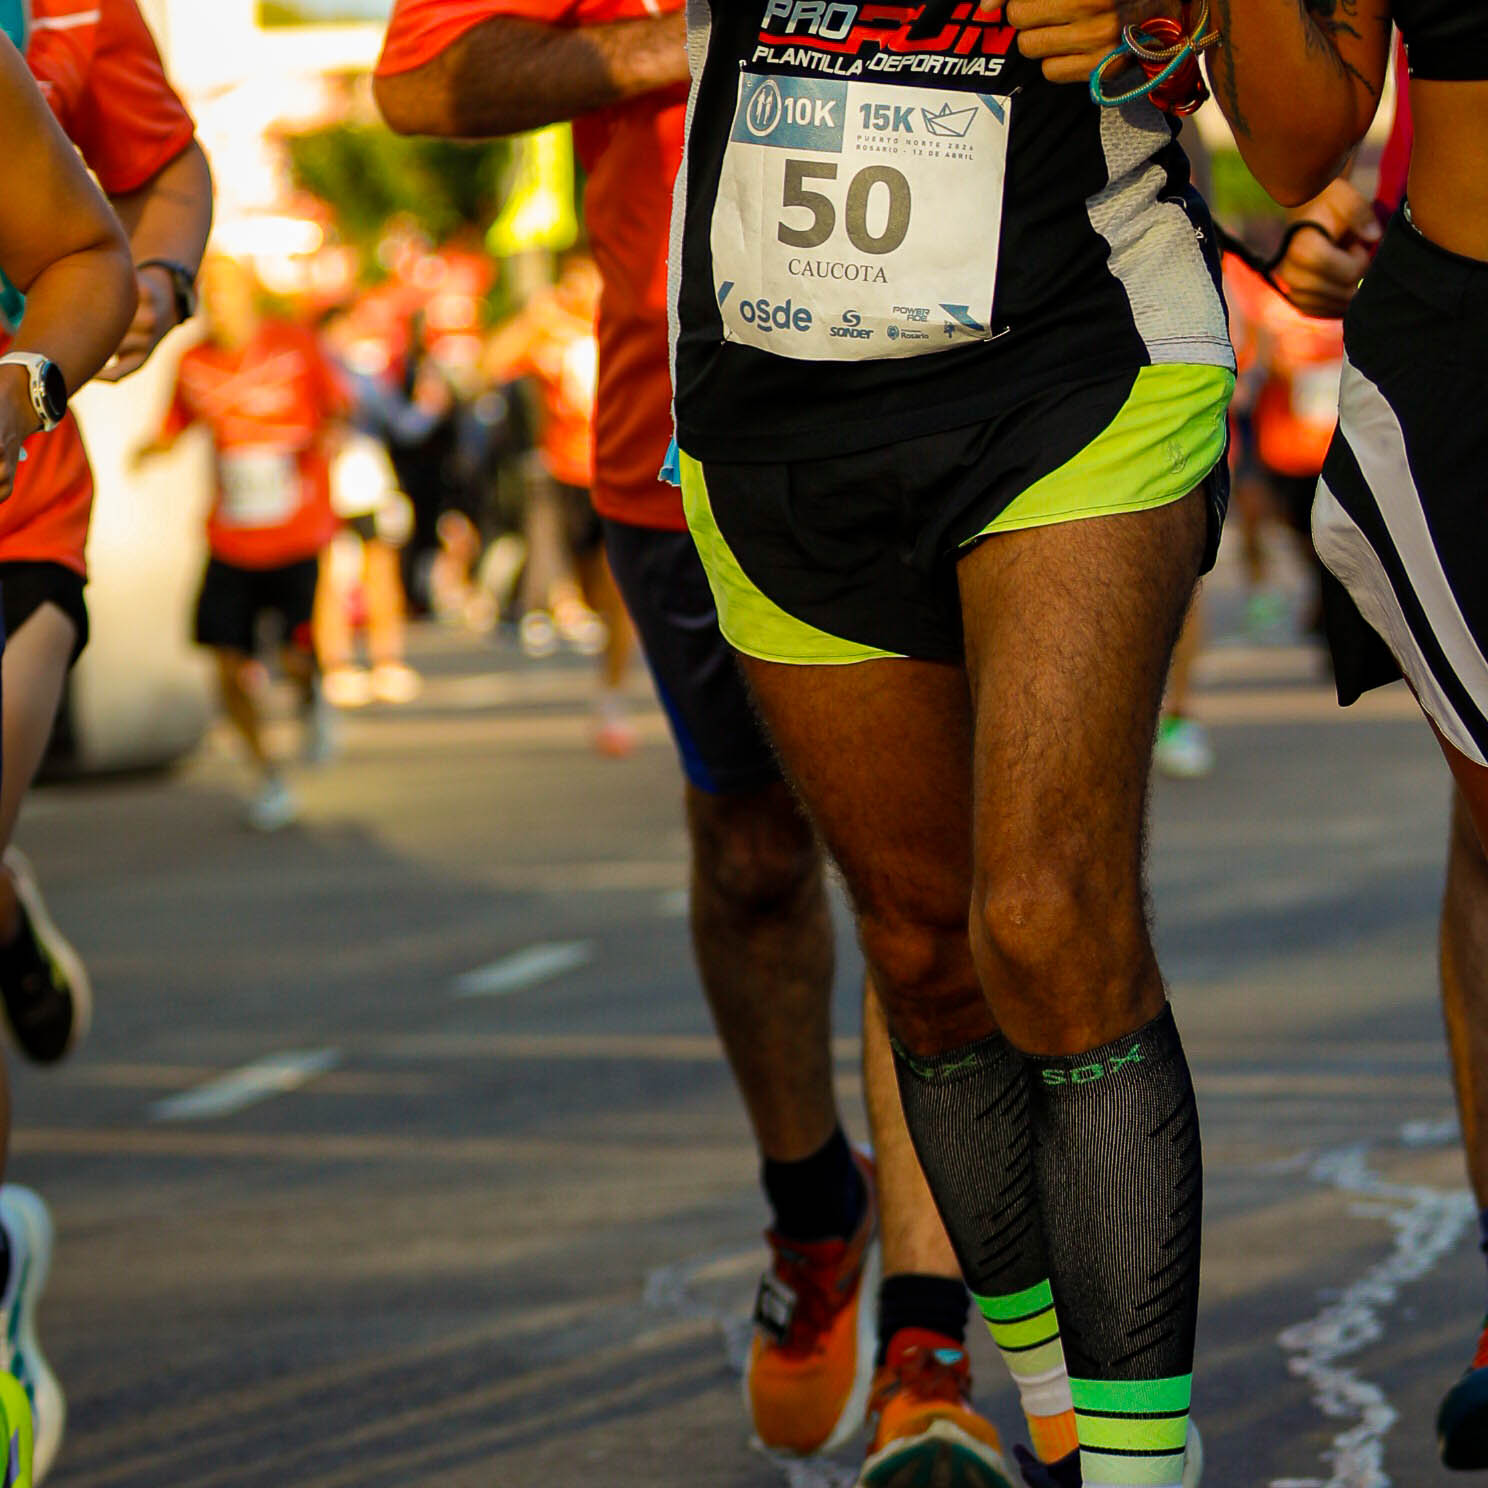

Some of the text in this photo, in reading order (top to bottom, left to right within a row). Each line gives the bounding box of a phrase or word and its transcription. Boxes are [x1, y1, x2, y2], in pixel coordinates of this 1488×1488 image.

[868, 52, 1006, 76] DEPORTIVAS
[784, 96, 837, 128] 10K
[859, 102, 917, 133] 15K
[856, 135, 899, 144] PUERTO
[905, 139, 941, 148] NORTE
[856, 144, 899, 153] ROSARIO
[945, 152, 974, 160] ABRIL
[777, 158, 912, 255] 50
[788, 258, 888, 284] CAUCOTA
[739, 298, 812, 333] osde
[901, 331, 929, 340] Rosario
